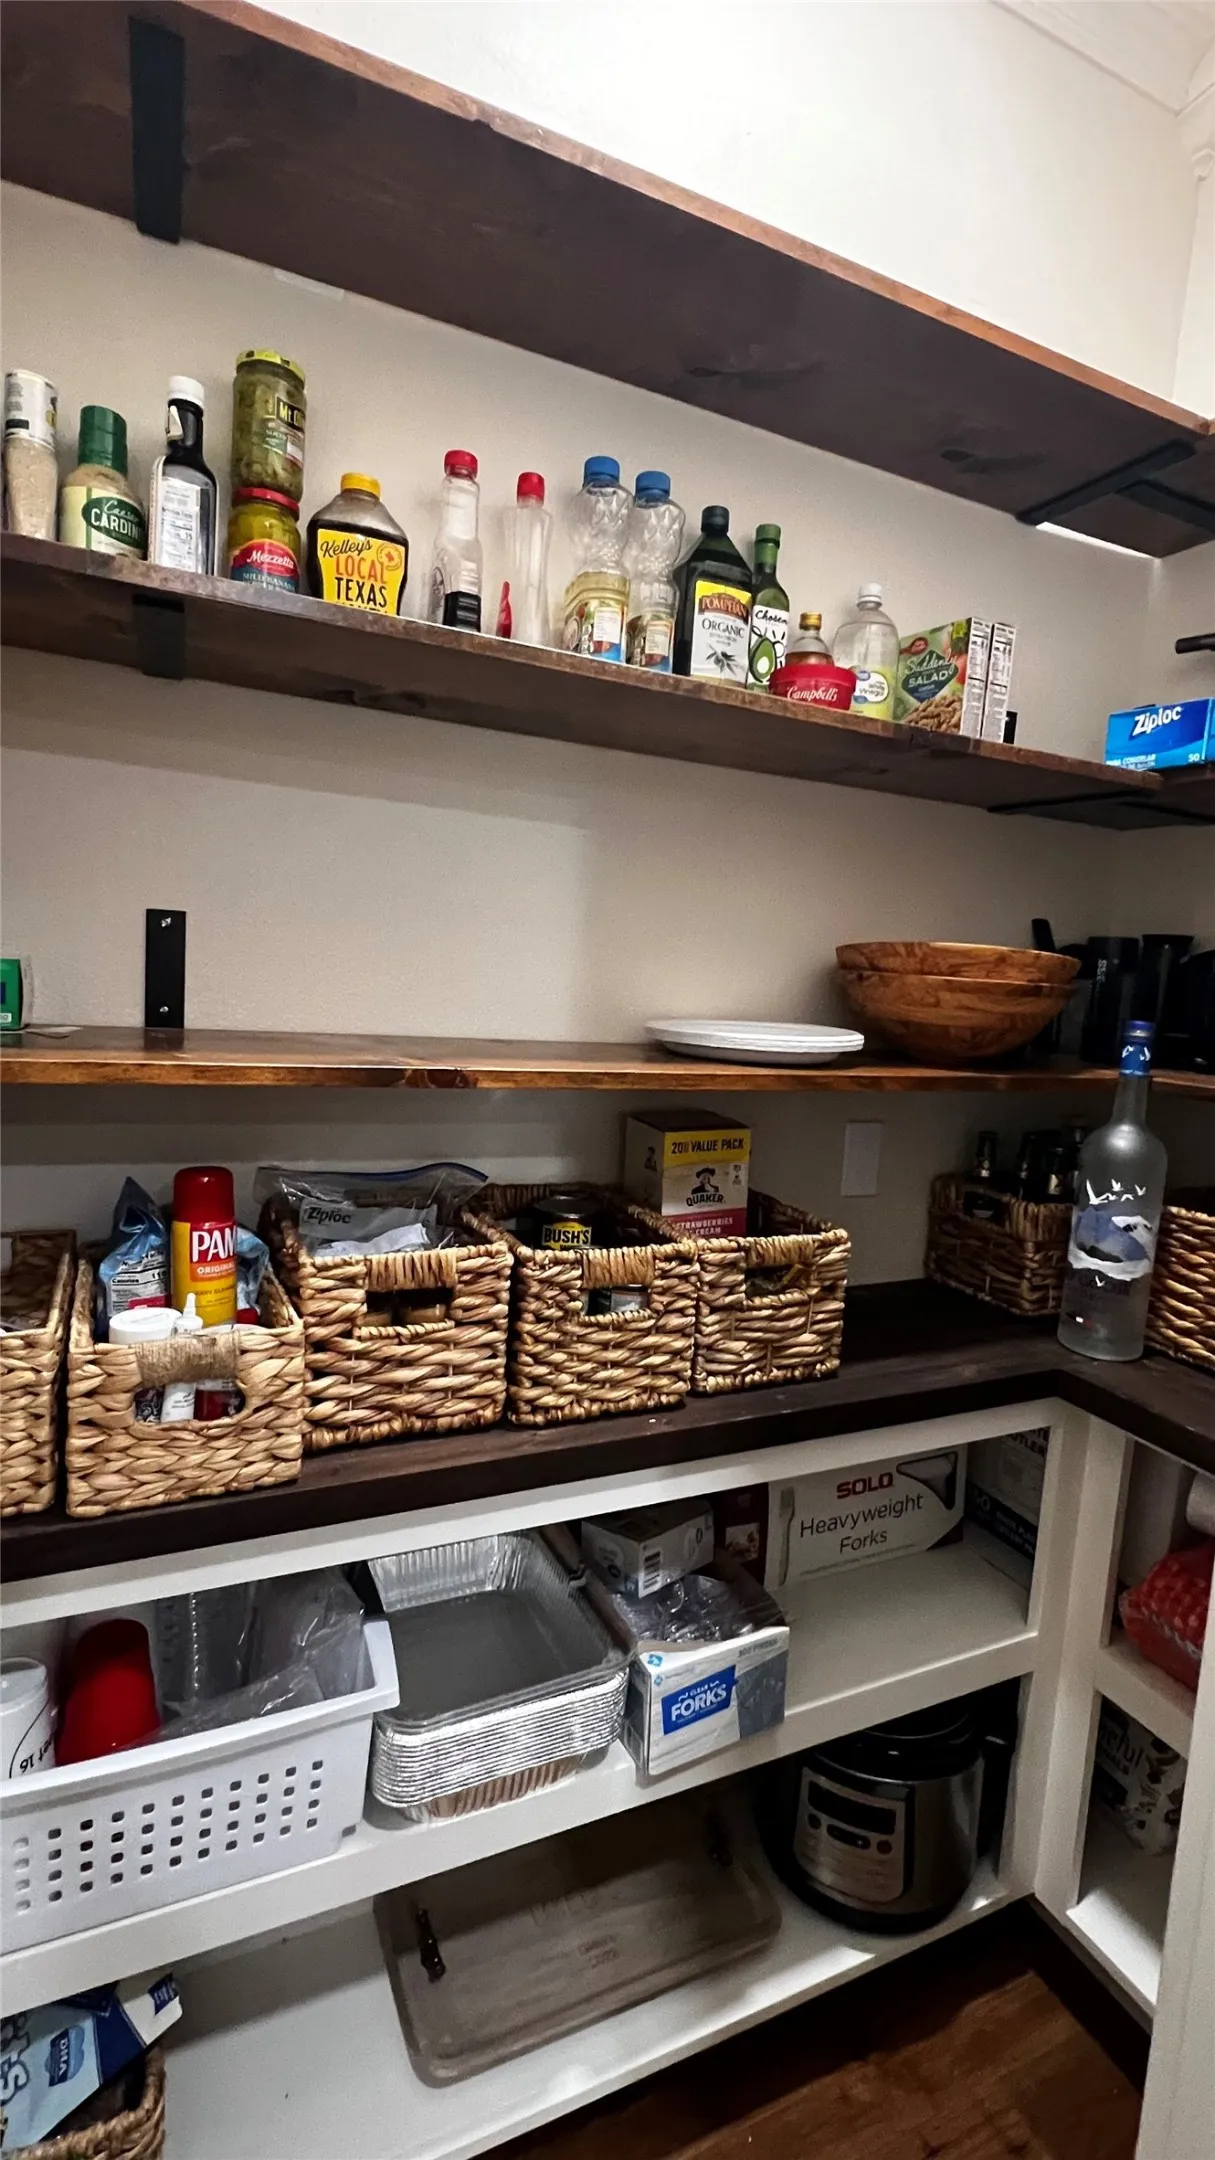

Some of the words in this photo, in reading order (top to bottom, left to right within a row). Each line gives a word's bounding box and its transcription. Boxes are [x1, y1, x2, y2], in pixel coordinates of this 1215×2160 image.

[91, 508, 140, 540] CARDIN
[246, 550, 294, 569] Mezzetta
[320, 538, 373, 558] Kelley's
[335, 555, 387, 584] LOCAL
[335, 576, 387, 608] TEXAS
[702, 597, 747, 618] POMPEIAN
[755, 609, 788, 625] Chosen
[702, 618, 745, 639] ORGANIC
[906, 648, 957, 675] Suddenly
[909, 671, 948, 688] SALAD
[1132, 706, 1182, 736] Ziploc
[691, 1140, 719, 1152] VALUE
[721, 1138, 745, 1150] PACK
[686, 1193, 725, 1207] QUAKER
[308, 1206, 351, 1225] Ziploc
[192, 1226, 236, 1263] PAM
[543, 1228, 590, 1245] BUSH'S
[836, 1472, 895, 1499] SOLO
[800, 1493, 924, 1538] Heavyweight
[840, 1530, 888, 1555] Forks
[671, 1684, 727, 1722] FORKS
[58, 2037, 69, 2075] DHA
